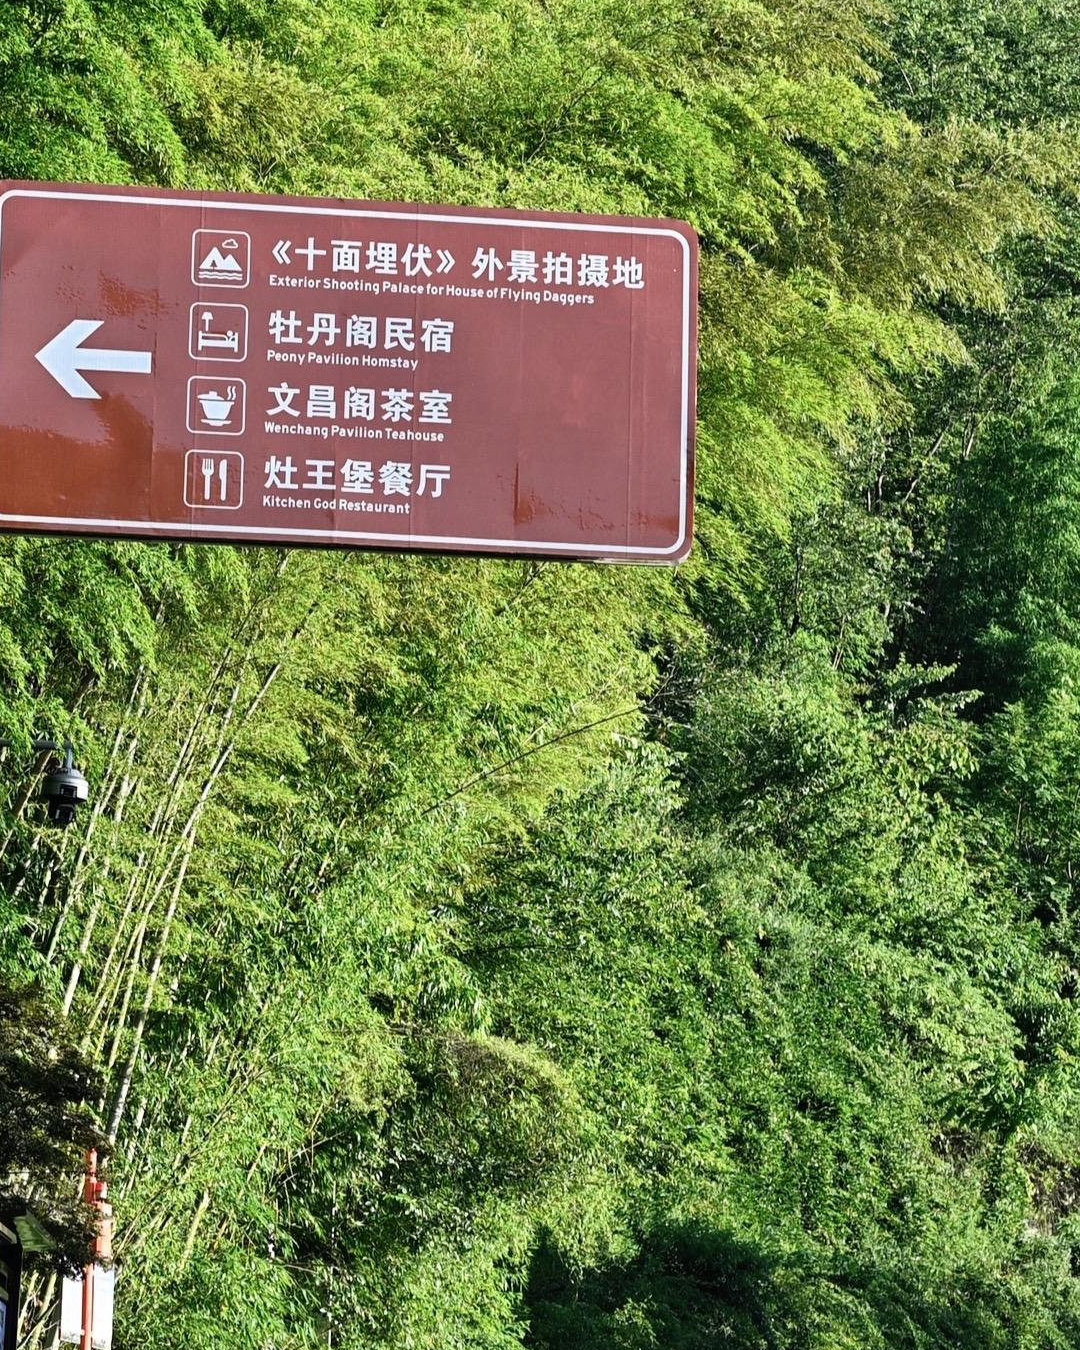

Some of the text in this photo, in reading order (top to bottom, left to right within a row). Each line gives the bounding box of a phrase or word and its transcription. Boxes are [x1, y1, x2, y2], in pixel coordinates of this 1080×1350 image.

[269, 274, 594, 306] Exterior Shooting Palace for House of Flying Daggers
[268, 309, 455, 353] 牡丹阁民宿
[267, 349, 419, 371] Peony Pavilion Homstay
[265, 381, 452, 424] 文昌阁茶室
[264, 421, 445, 442] Wenchang Pavilion Teahouse
[264, 455, 451, 498] 灶王堡餐厅
[262, 494, 411, 514] Kitchen God Restaurant
